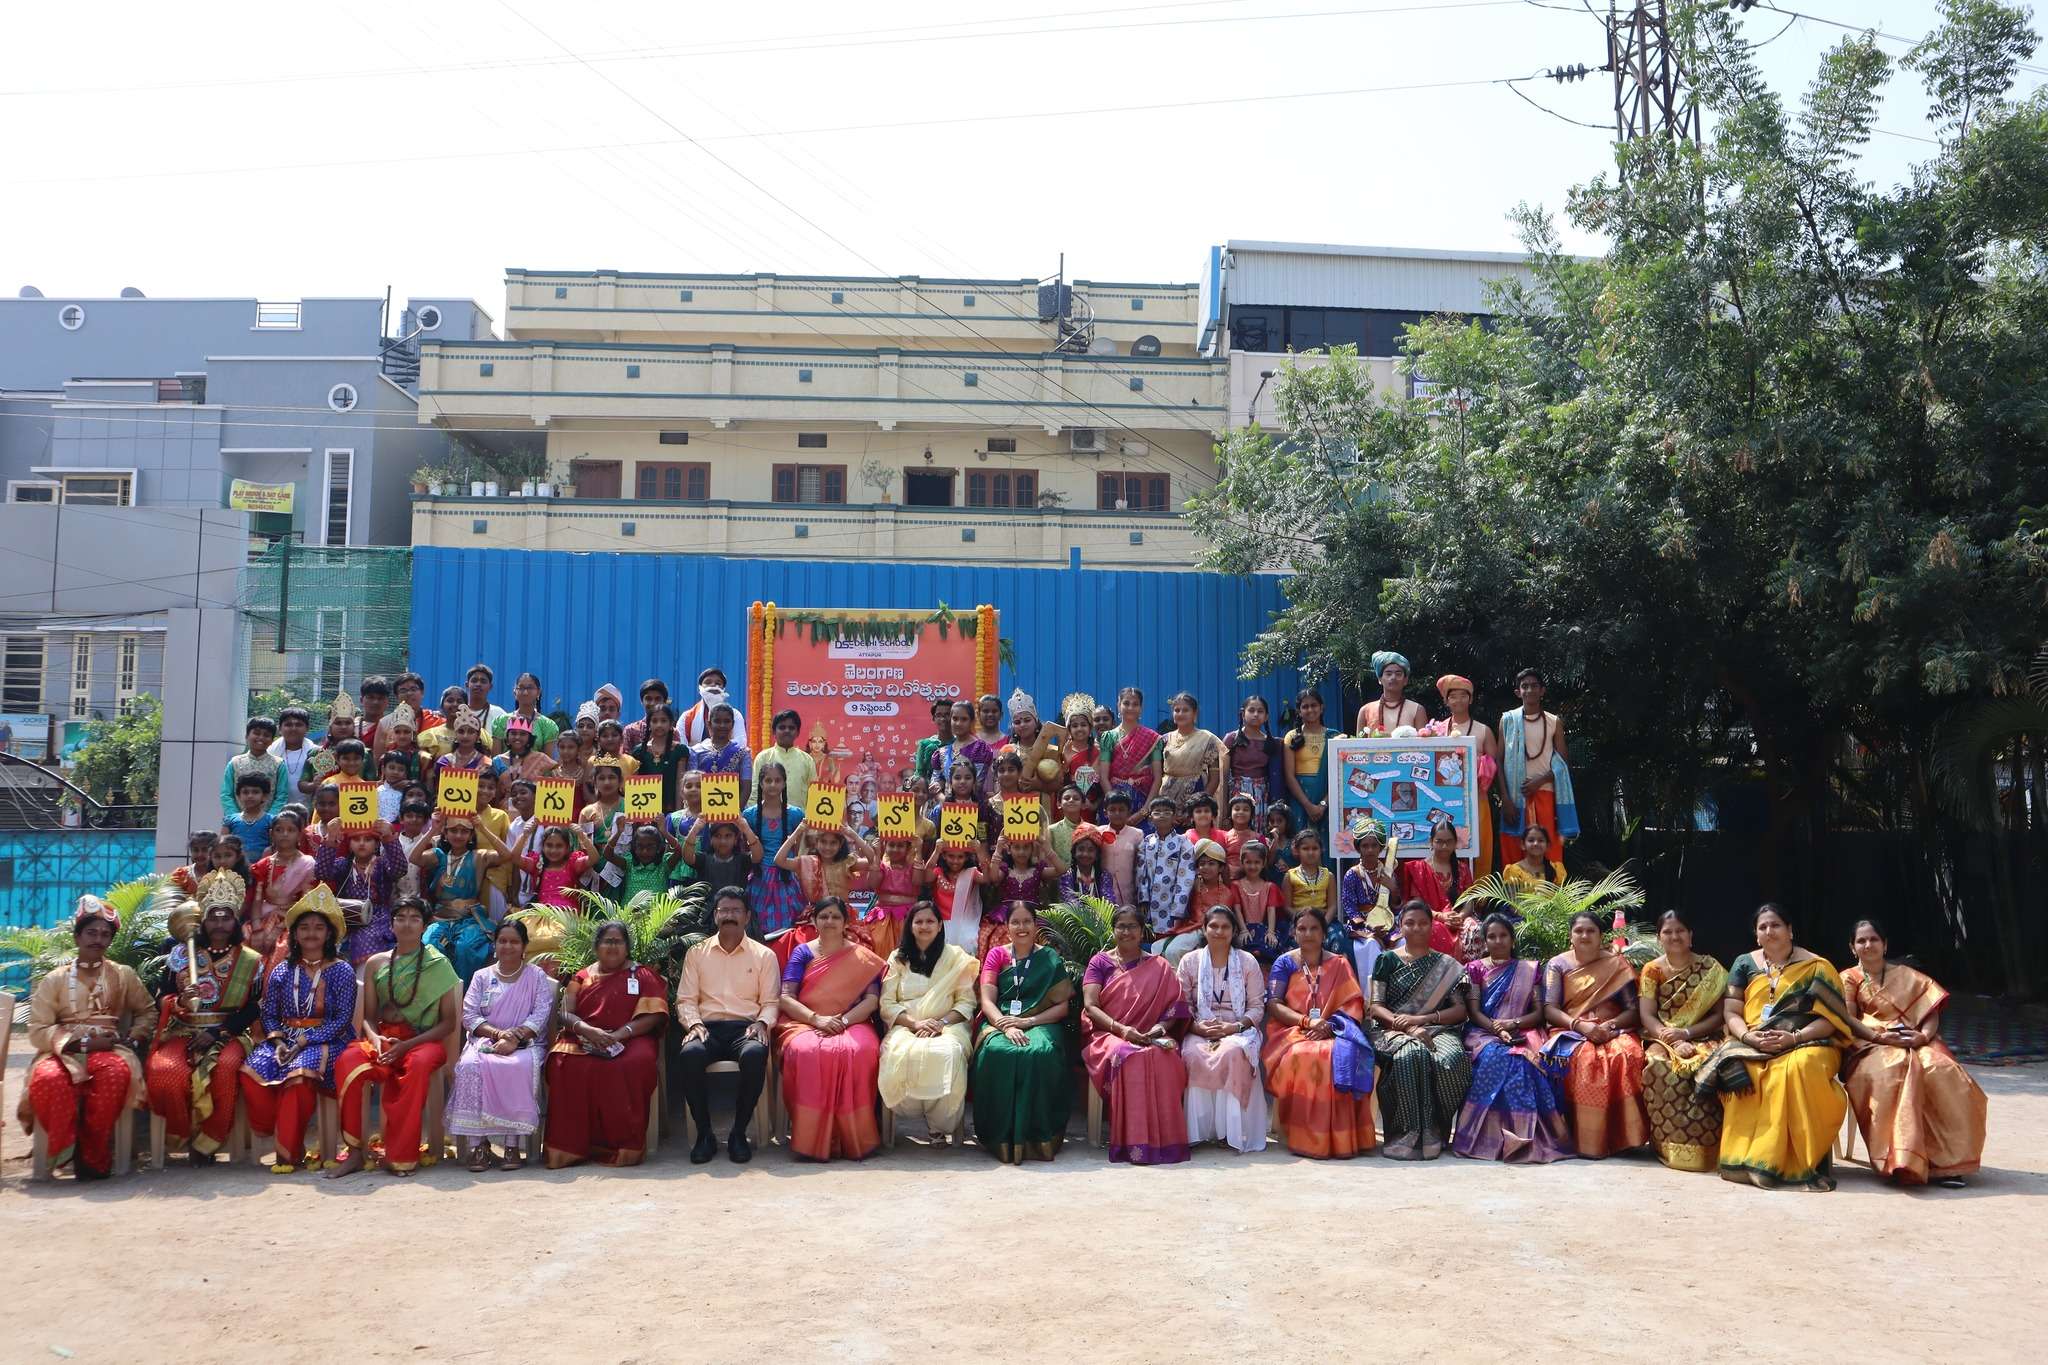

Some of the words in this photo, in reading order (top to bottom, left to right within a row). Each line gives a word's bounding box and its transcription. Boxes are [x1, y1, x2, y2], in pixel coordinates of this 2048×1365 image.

[845, 664, 904, 680] తెలంగాణ
[786, 681, 838, 696] తెలుగు
[842, 682, 883, 699] భాషా
[885, 680, 961, 701] దినోత్సవం
[860, 703, 892, 715] సెప్టెంబర్
[444, 787, 472, 803] లు
[543, 791, 565, 810] గు
[631, 792, 656, 810] భా
[707, 788, 734, 807] షా
[348, 796, 369, 815] తె
[815, 796, 834, 816] ది
[884, 801, 910, 825] నో
[1007, 807, 1040, 825] వం
